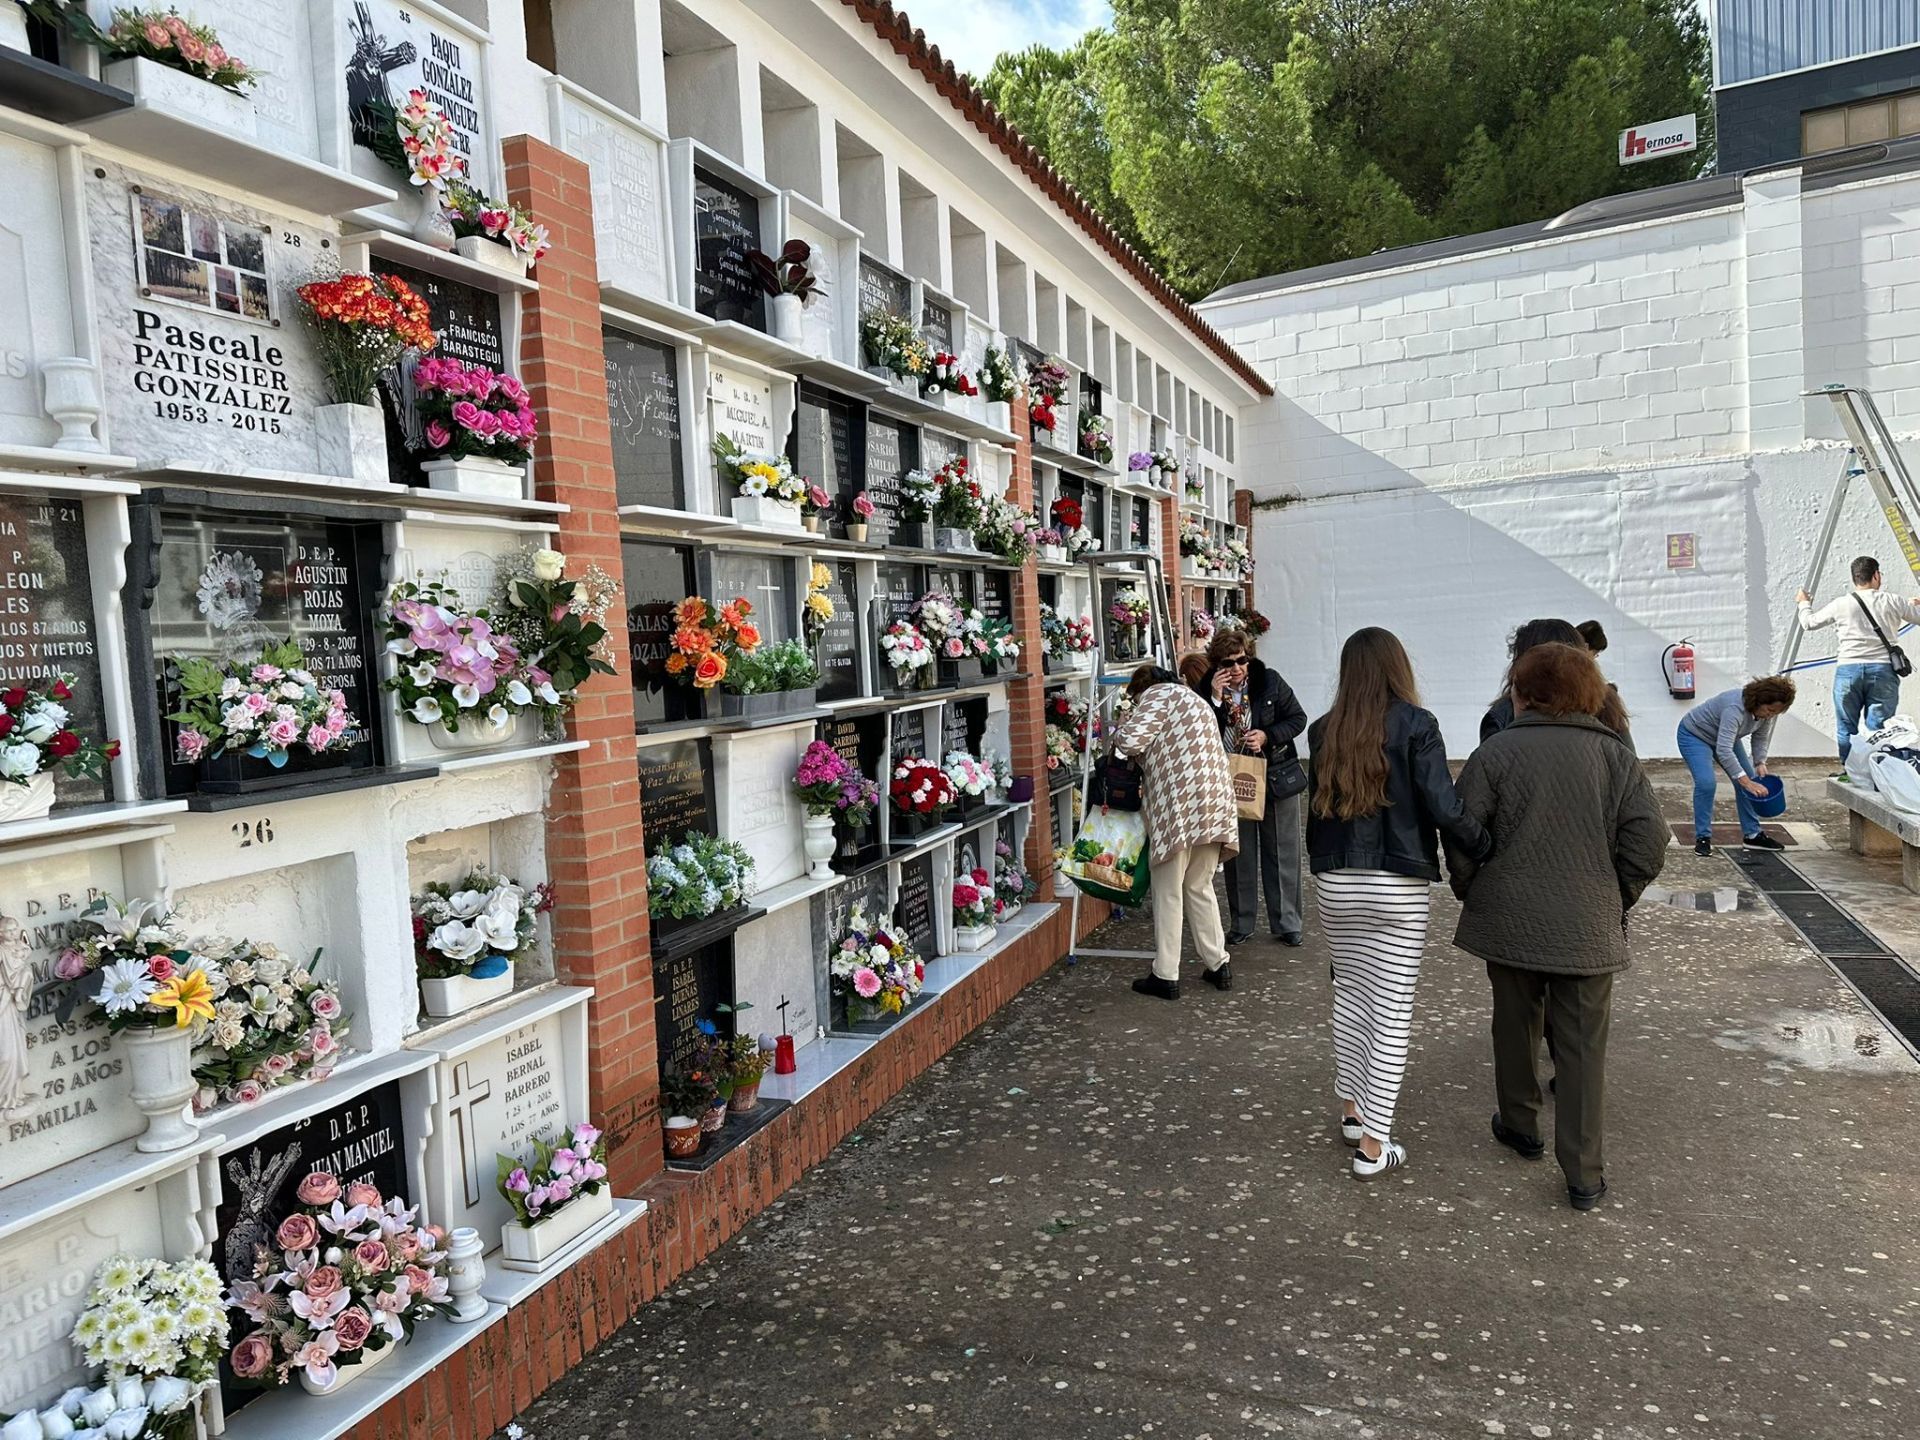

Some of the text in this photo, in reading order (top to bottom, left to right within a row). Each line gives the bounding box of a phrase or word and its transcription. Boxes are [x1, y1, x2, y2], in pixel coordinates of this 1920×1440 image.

[400, 10, 411, 24] 35
[430, 32, 461, 70] PAQUI
[422, 57, 473, 105] GONZALEZ
[1625, 129, 1683, 157] hernosa
[282, 231, 301, 247] 28
[428, 283, 438, 295] 34
[132, 309, 283, 367] Pascale
[449, 324, 497, 347] FRANCISCO
[442, 338, 502, 365] BARASTEGUI
[132, 343, 289, 391] PATISSIER
[134, 370, 293, 415] GONZALEZ
[154, 400, 208, 424] 1953
[232, 412, 281, 434] 2015
[726, 406, 759, 427] MIGUEL
[60, 508, 76, 522] 21
[0, 572, 44, 589] EON
[295, 567, 348, 585] AGUSTIN
[0, 597, 29, 614] ES
[303, 590, 344, 608] ROJAS
[825, 593, 848, 604] ERCEDES
[627, 615, 669, 633] SALAS
[840, 611, 855, 622] LOPEZ
[33, 622, 47, 635] 87
[30, 643, 38, 657] Y
[44, 641, 94, 657] NIETOS
[337, 636, 357, 650] 2007
[306, 653, 362, 671] LOS 71 AÑOS
[321, 674, 356, 689] ESPOSA
[837, 722, 856, 735] DAVID
[838, 746, 858, 759] PEREZ
[231, 817, 274, 848] 26
[672, 969, 696, 990] ISABEL
[672, 982, 698, 1006] DUEÑAS
[672, 997, 700, 1021] LINARES
[50, 1035, 111, 1069] A LOS
[506, 1038, 542, 1063] ISABEL
[43, 1058, 123, 1099] 76 AÑOS
[506, 1056, 546, 1083] BERNAL
[504, 1071, 551, 1103] BARRERO
[9, 1097, 98, 1143] FAMILIA
[500, 1130, 507, 1141] A
[511, 1120, 525, 1136] LOS
[344, 1127, 394, 1171] MANUEL
